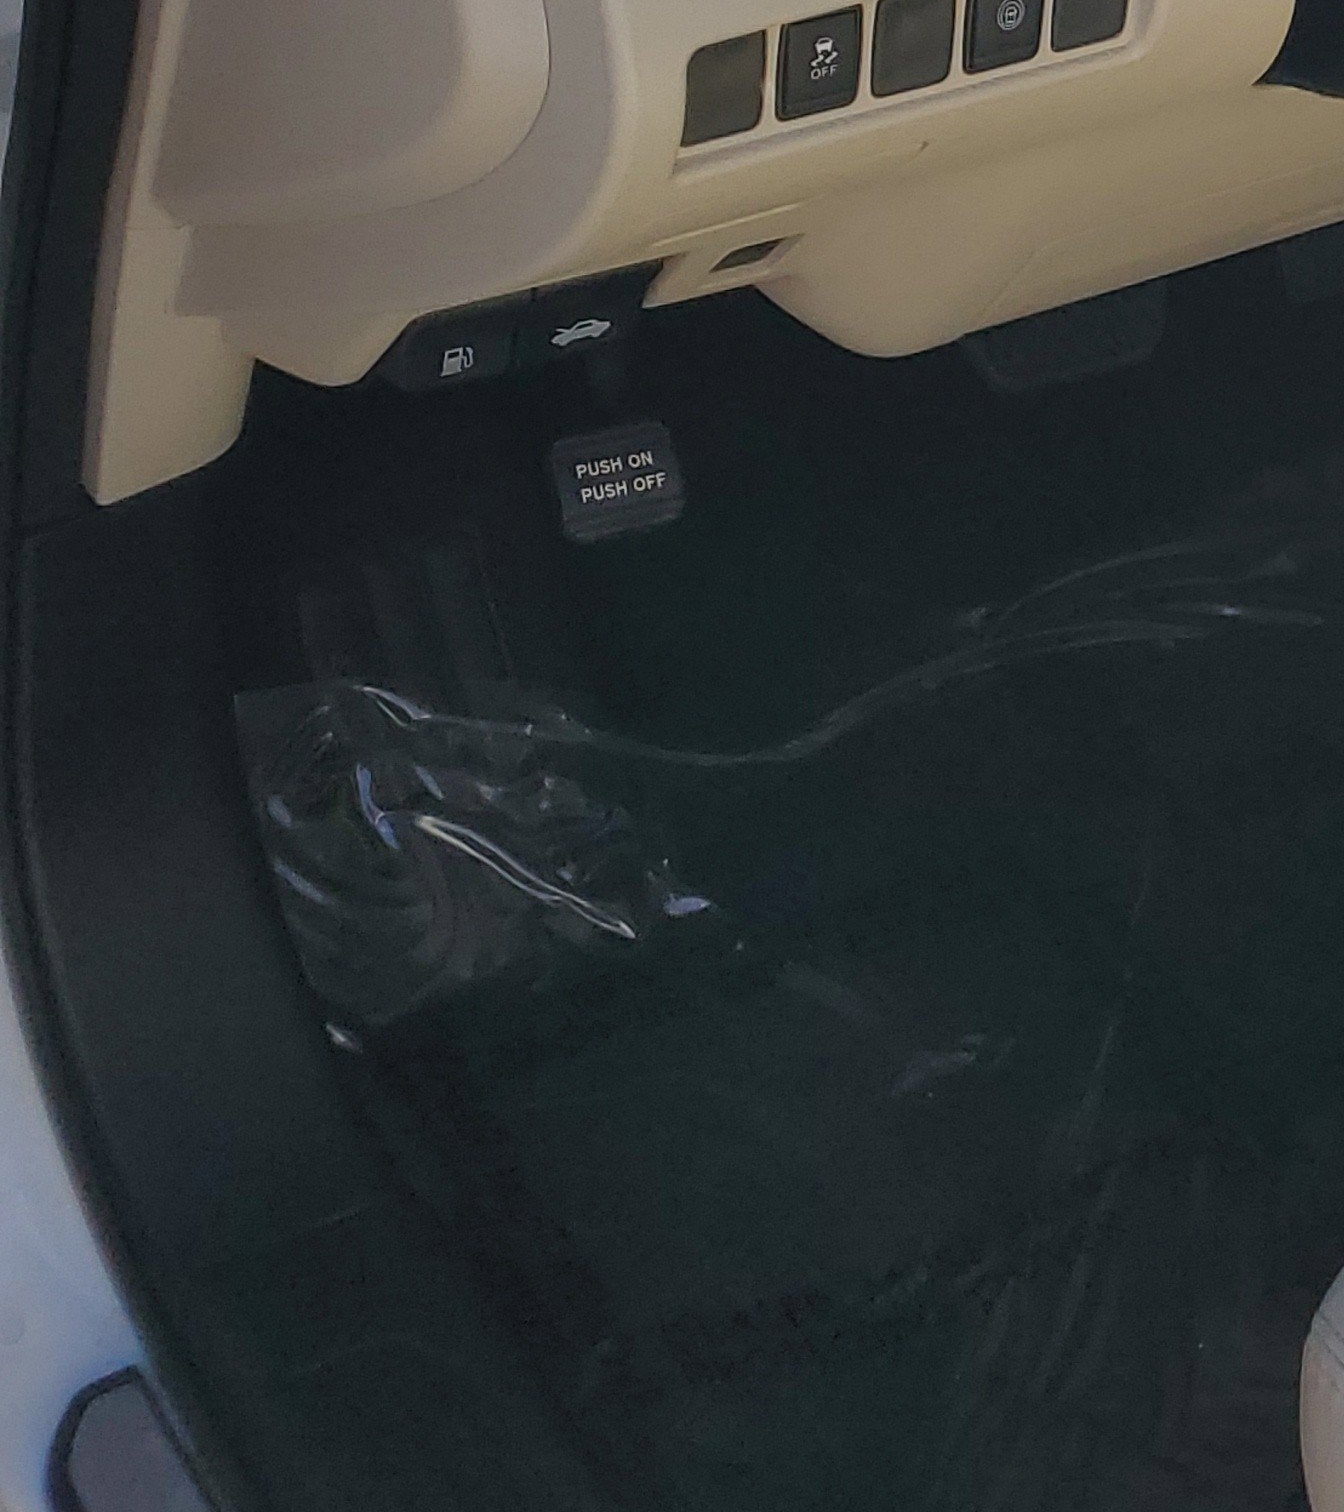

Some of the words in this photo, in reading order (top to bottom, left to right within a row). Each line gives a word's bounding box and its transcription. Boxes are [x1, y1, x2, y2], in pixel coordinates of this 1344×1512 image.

[810, 64, 837, 80] OFF
[575, 456, 623, 479] PUSH
[627, 450, 653, 469] ON
[580, 480, 628, 503] PUSH
[633, 472, 666, 492] OFF
